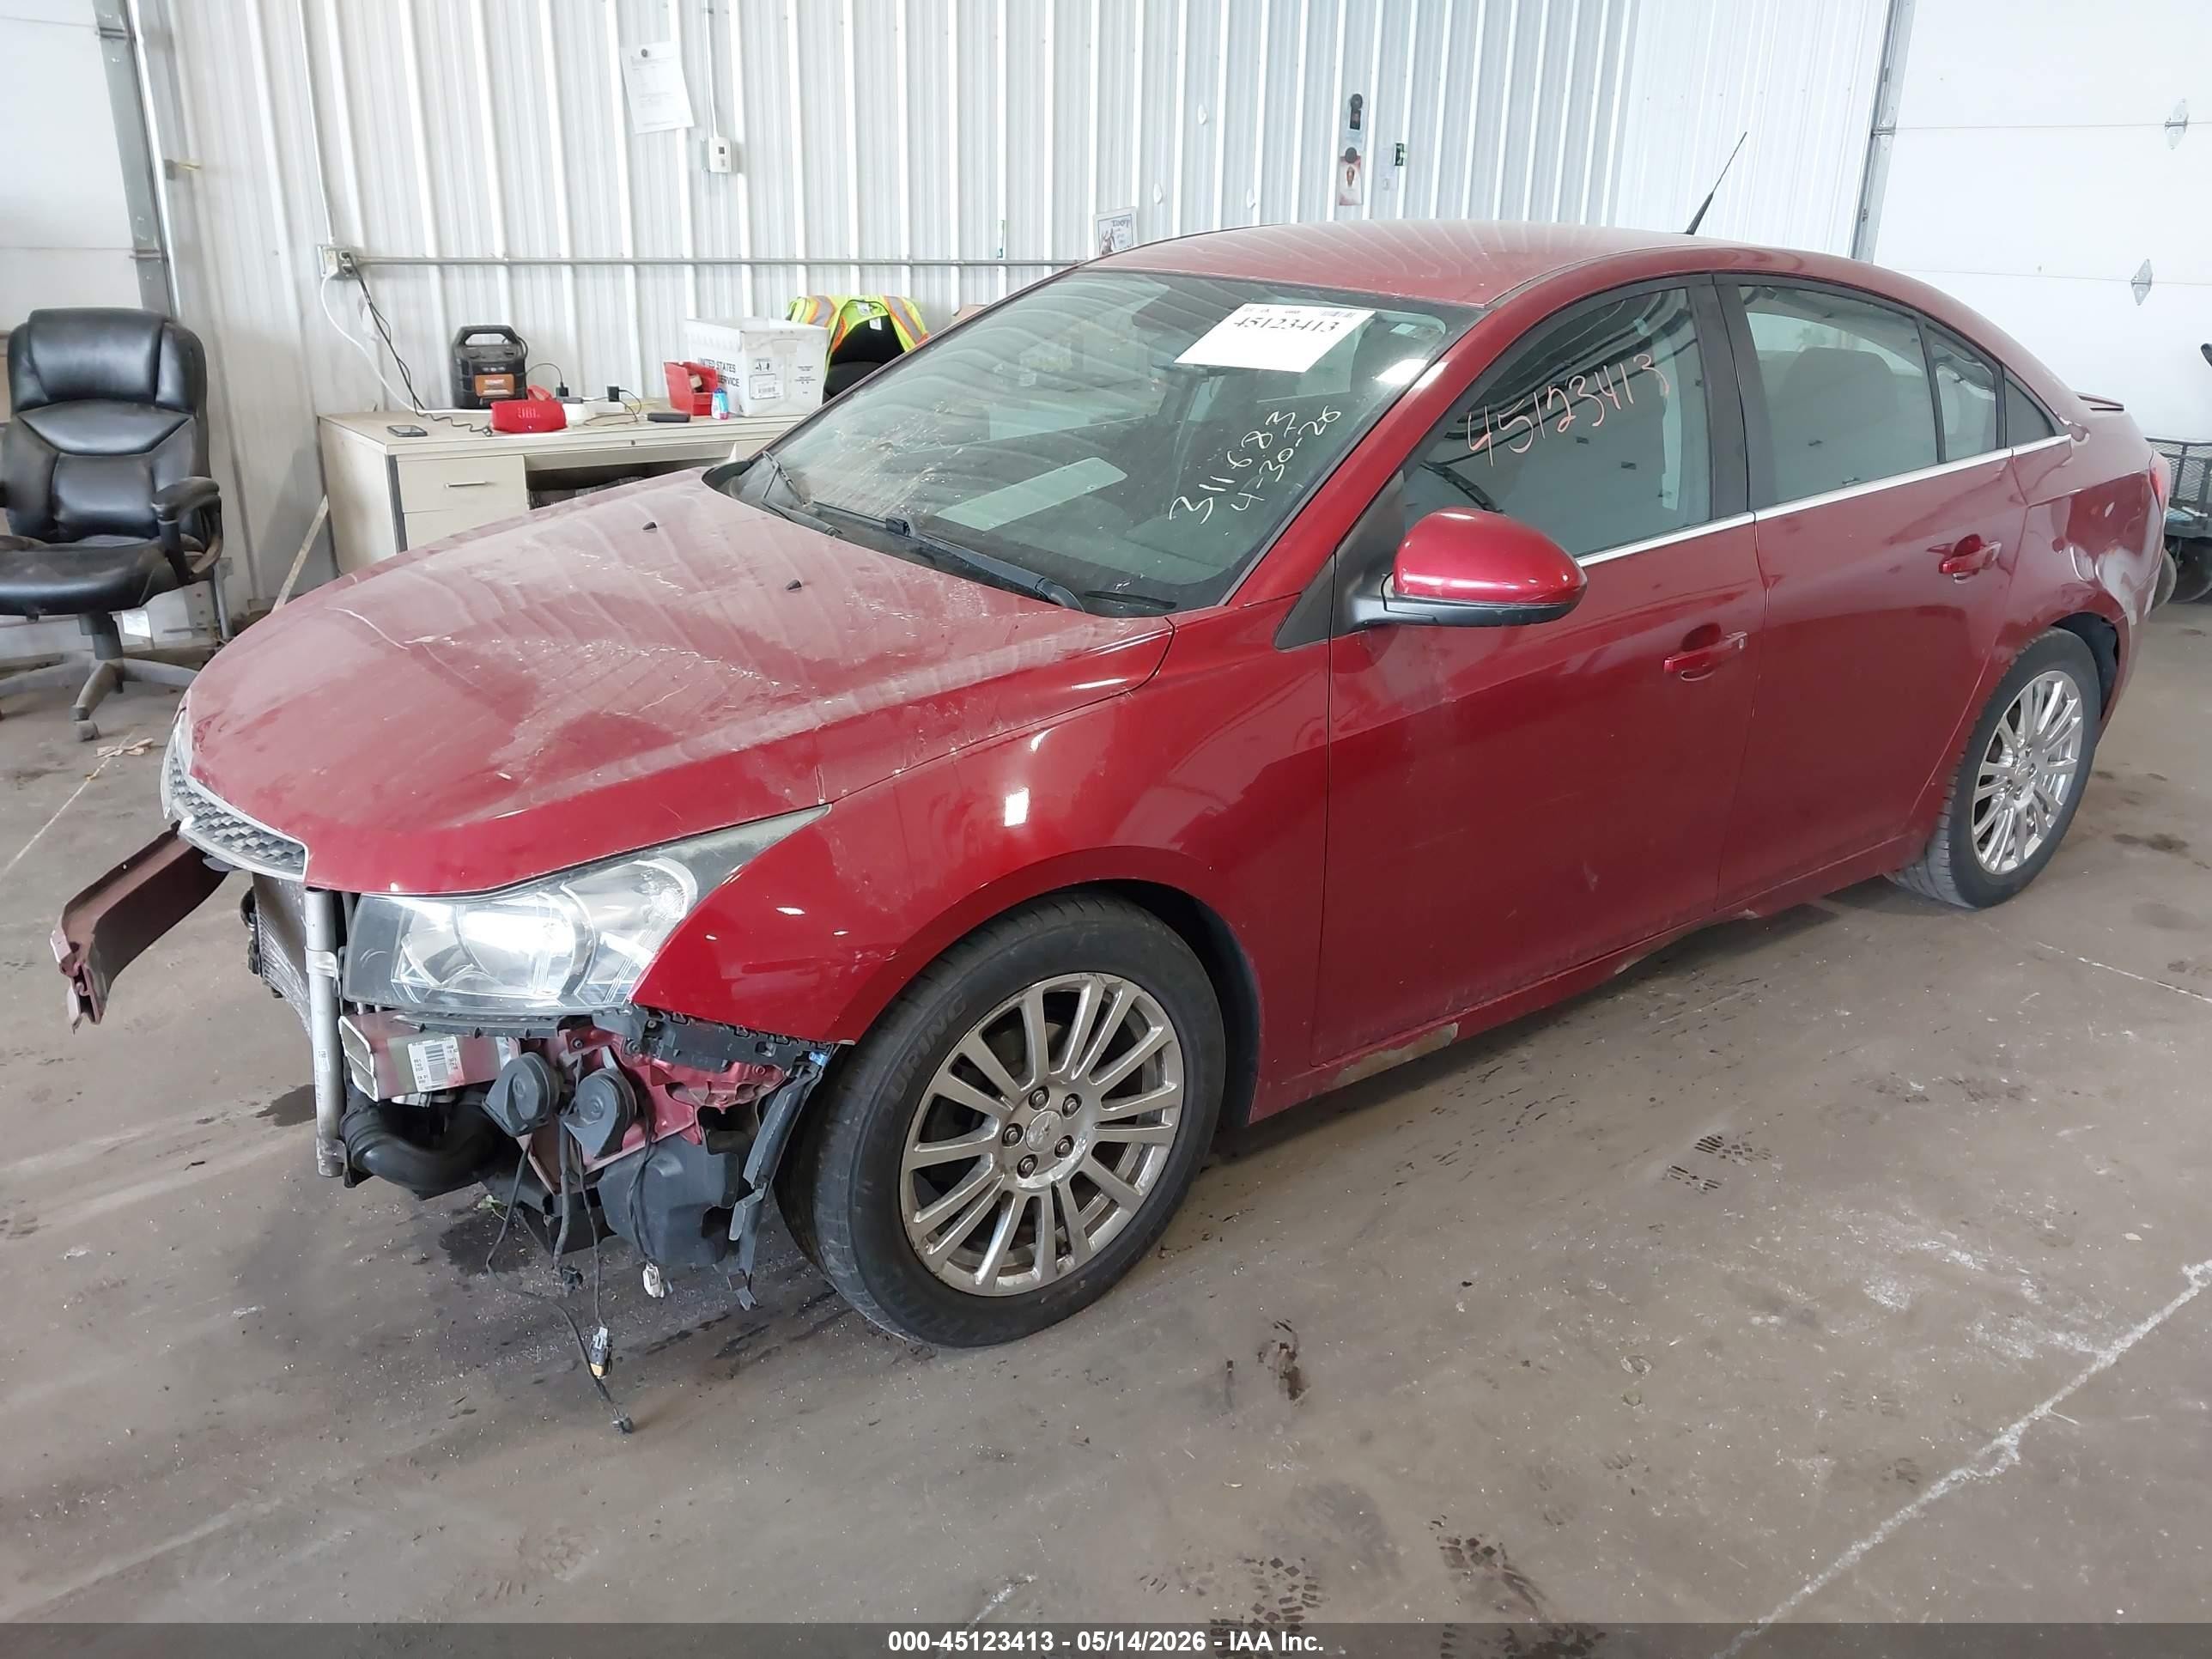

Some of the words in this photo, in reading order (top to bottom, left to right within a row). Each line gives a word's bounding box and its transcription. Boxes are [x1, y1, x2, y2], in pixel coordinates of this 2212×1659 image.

[716, 360, 737, 374] STATES
[1233, 315, 1340, 333] 45123413
[1230, 404, 1342, 512] 4-30-26
[1467, 353, 1670, 468] 45123413
[1169, 410, 1297, 525] 311683
